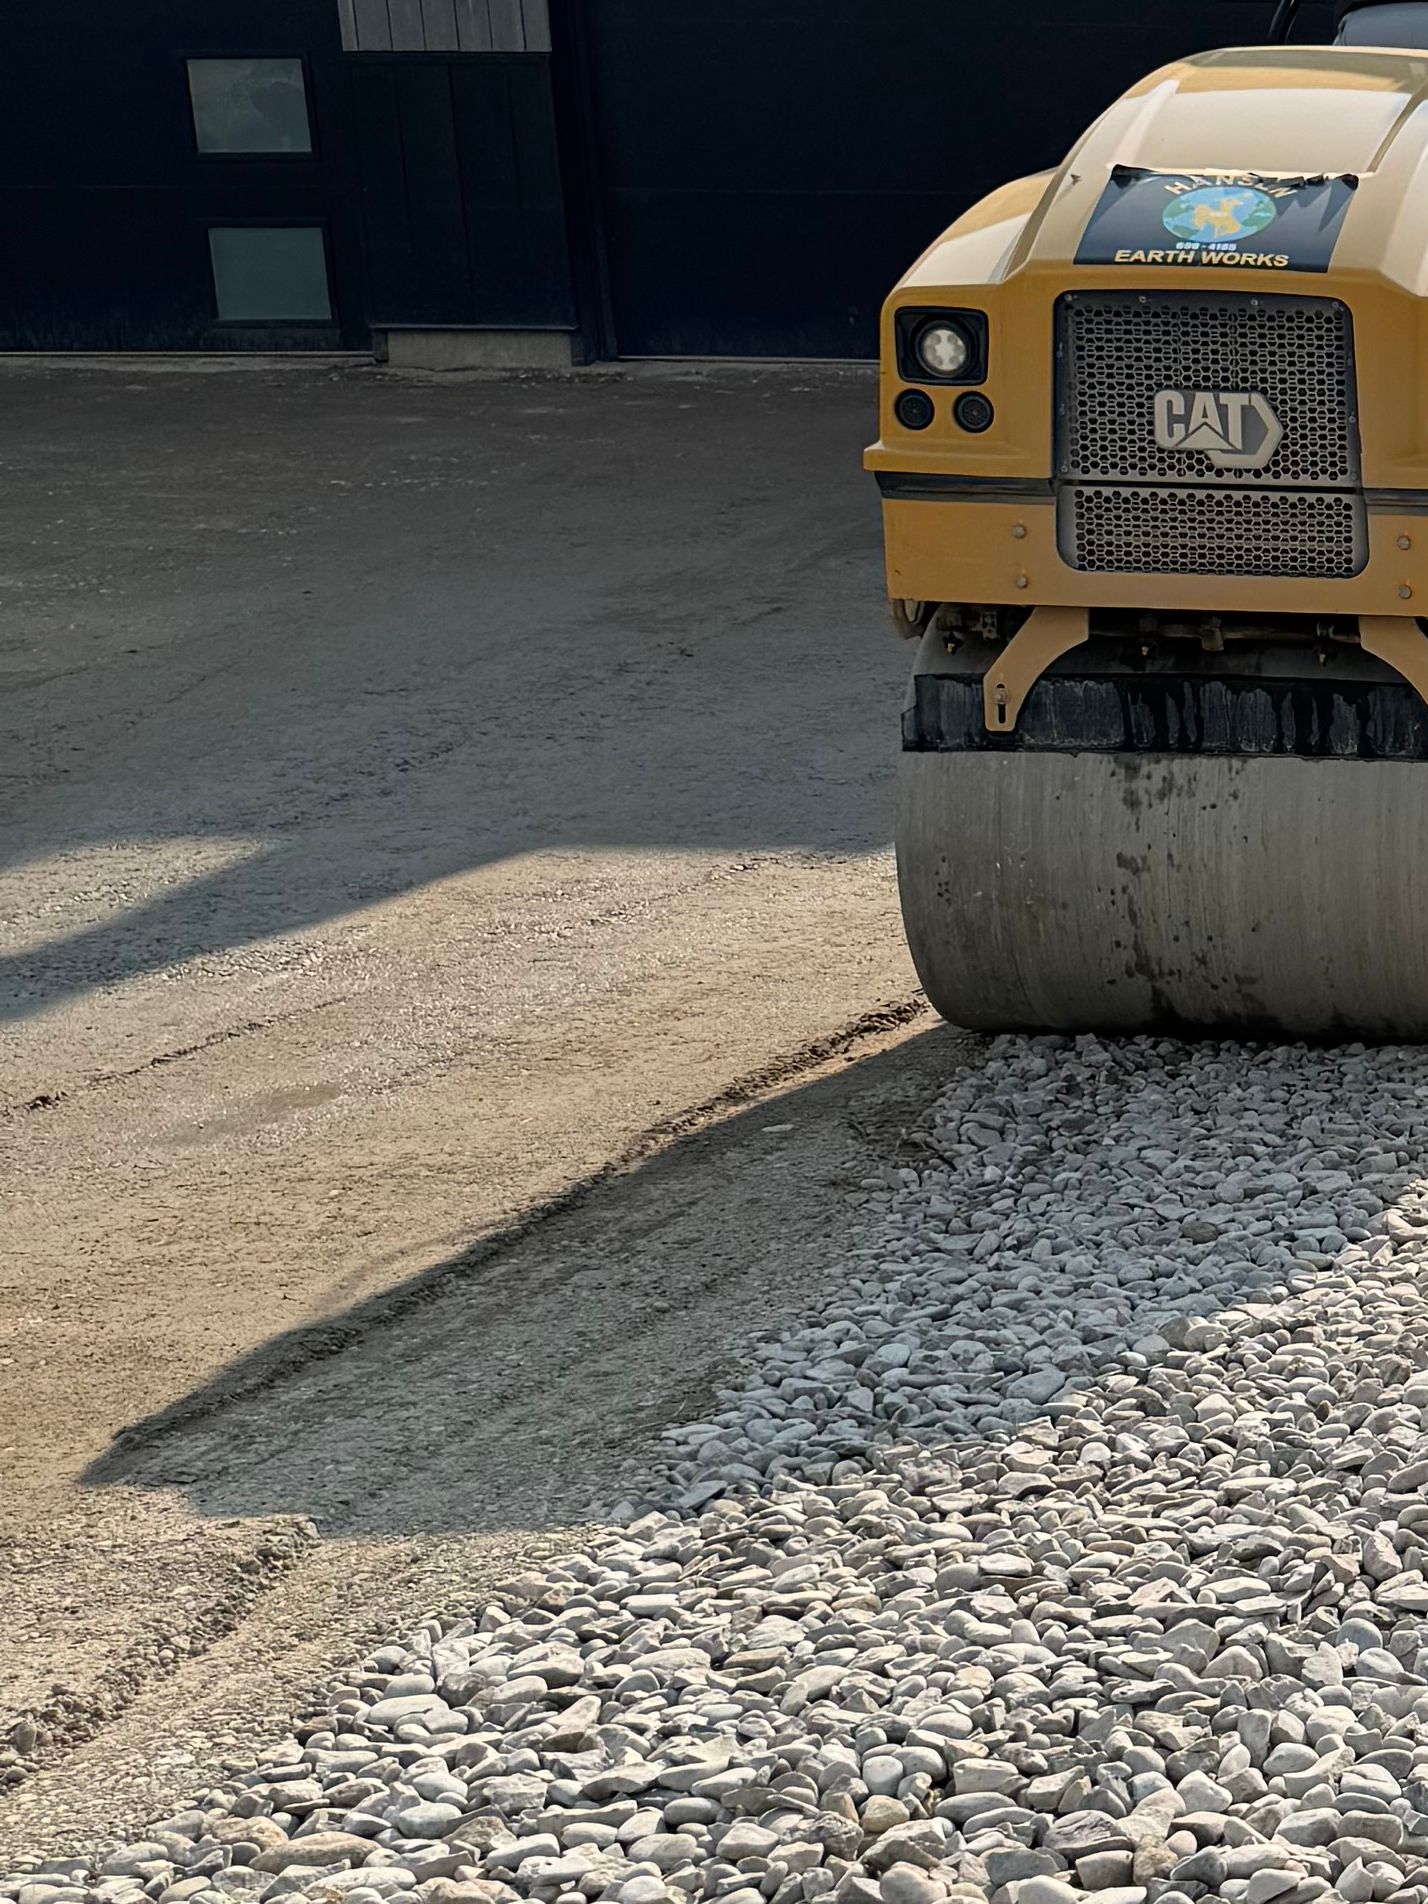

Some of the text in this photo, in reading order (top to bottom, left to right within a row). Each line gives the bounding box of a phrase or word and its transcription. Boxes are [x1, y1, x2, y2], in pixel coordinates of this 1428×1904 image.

[1114, 249, 1289, 267] EARTH WORKS
[1154, 390, 1250, 451] CAT
